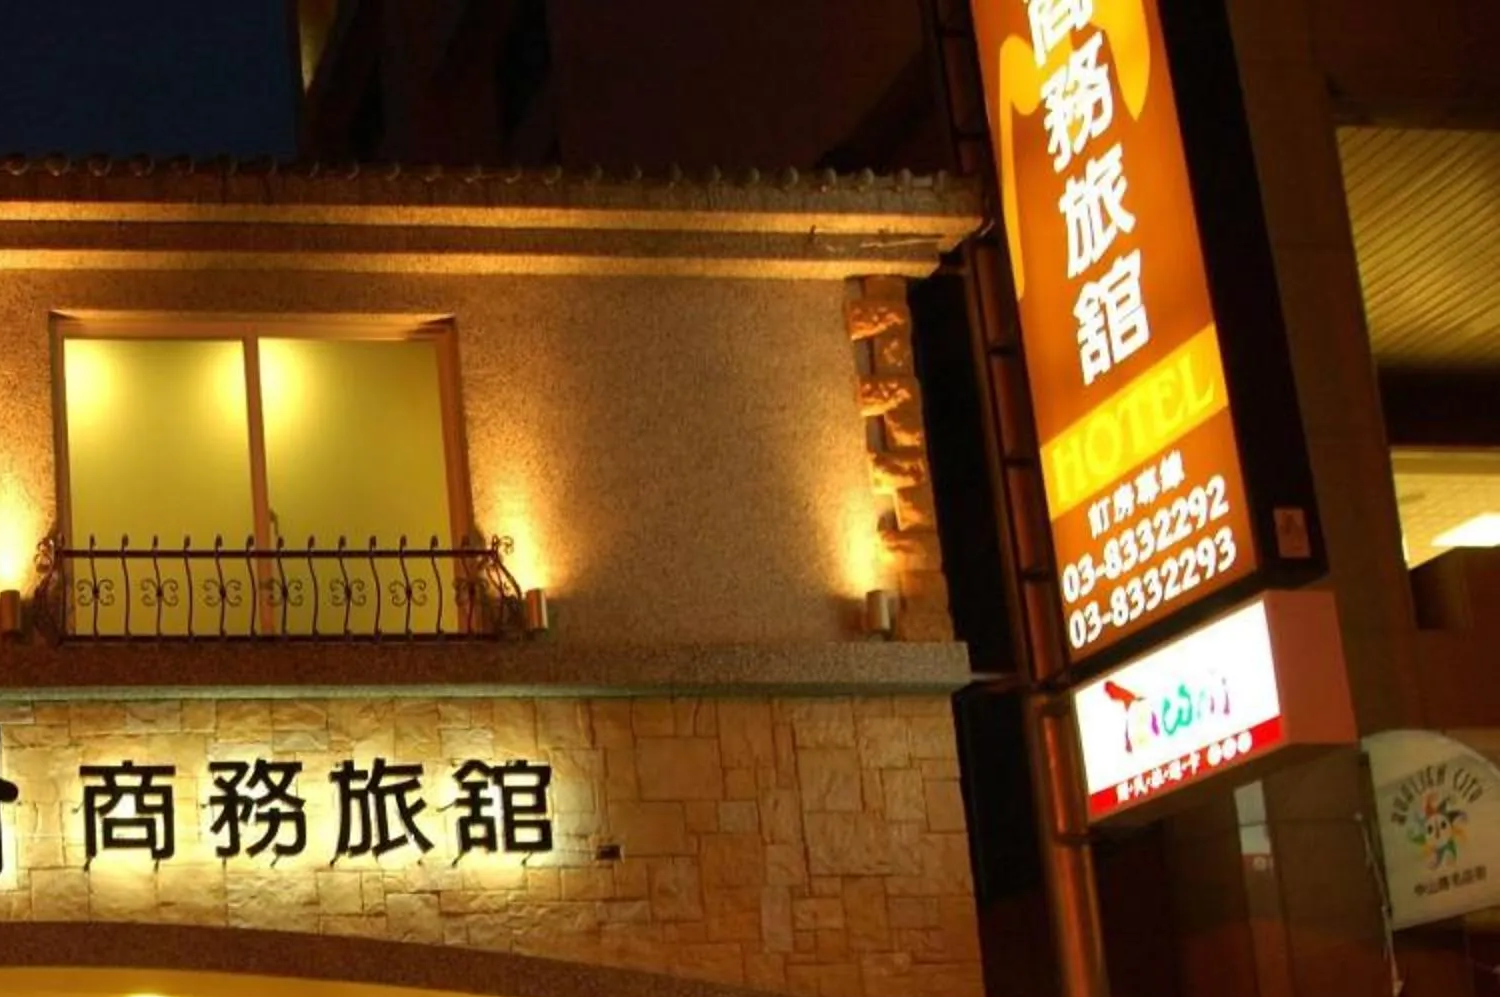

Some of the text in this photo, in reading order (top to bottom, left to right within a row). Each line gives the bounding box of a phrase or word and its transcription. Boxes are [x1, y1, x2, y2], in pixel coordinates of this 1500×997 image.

[1051, 351, 1215, 505] HOTEL
[1062, 474, 1230, 604] 03-8332292
[1068, 526, 1237, 650] 03-8332293
